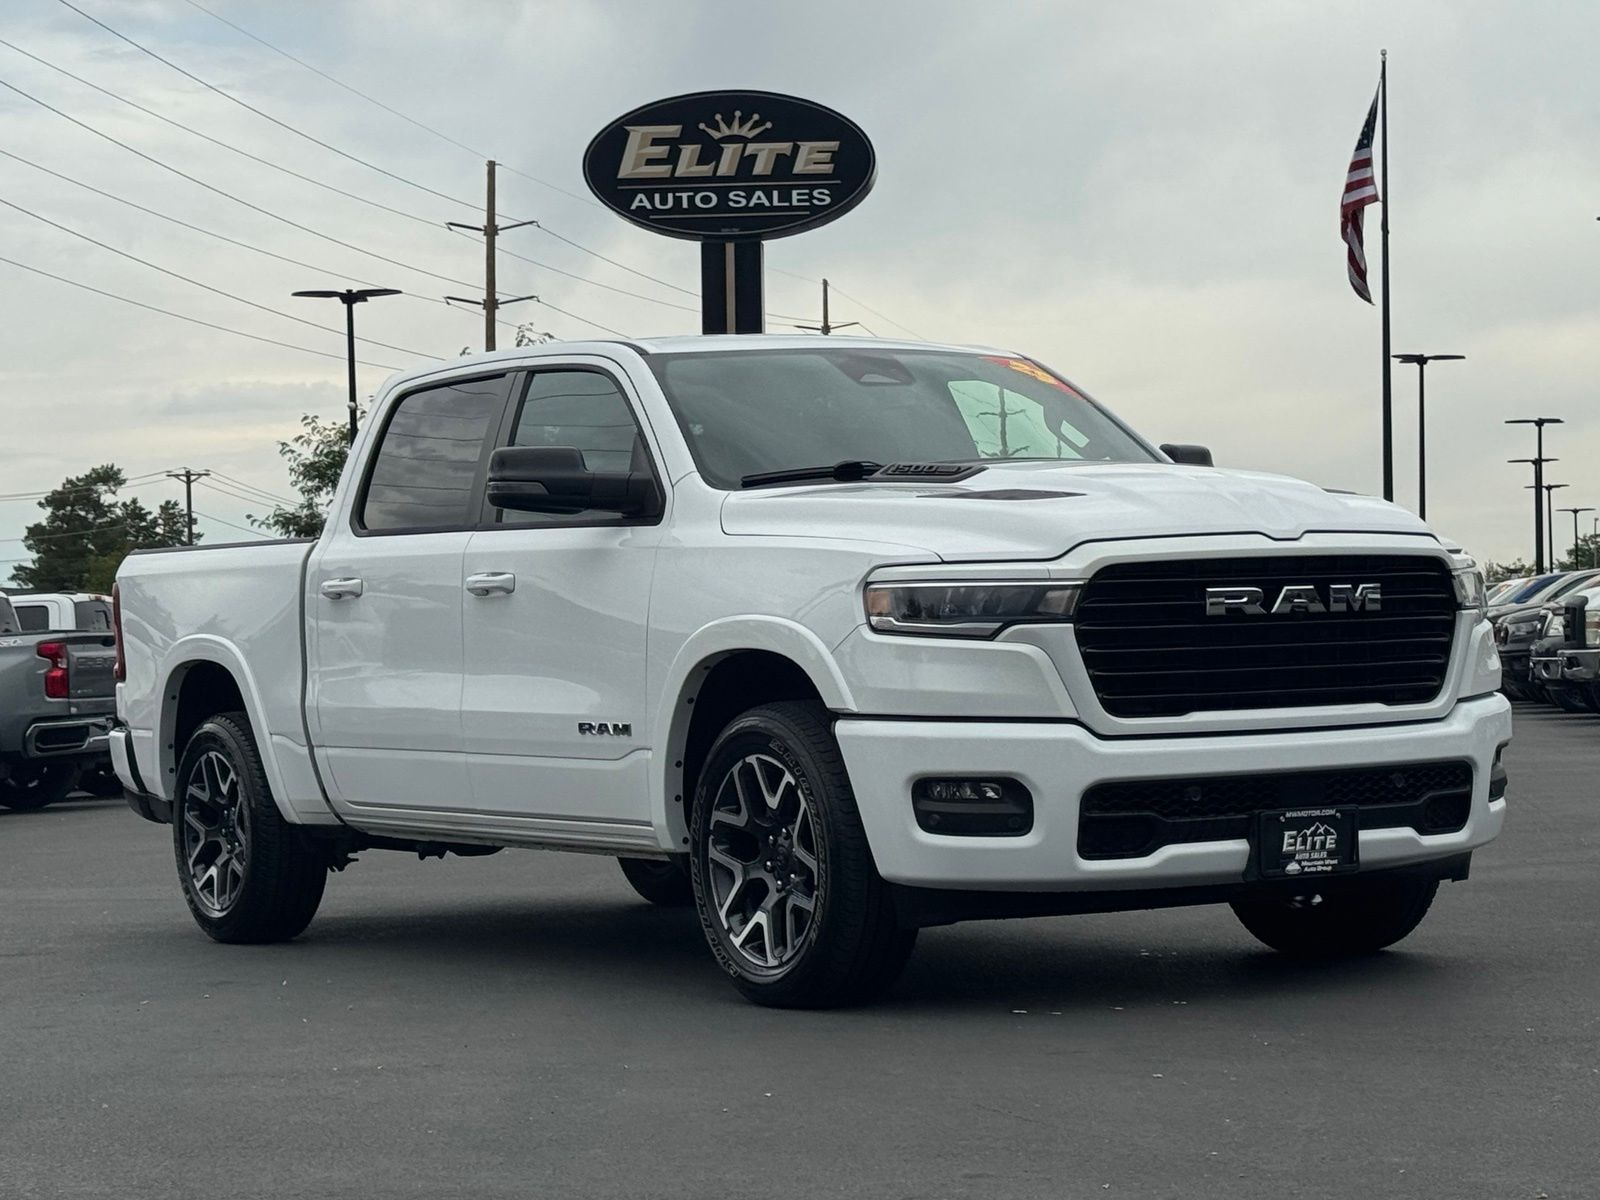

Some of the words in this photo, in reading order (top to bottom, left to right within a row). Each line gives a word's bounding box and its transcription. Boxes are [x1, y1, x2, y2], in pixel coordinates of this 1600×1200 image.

[616, 124, 841, 180] ELITE
[629, 191, 718, 211] AUTO
[727, 188, 832, 208] SALES
[1205, 583, 1382, 616] RAM
[577, 720, 633, 737] RAM
[1282, 830, 1337, 853] ELITE
[1295, 852, 1310, 860] AUTO
[1310, 851, 1328, 859] SALES
